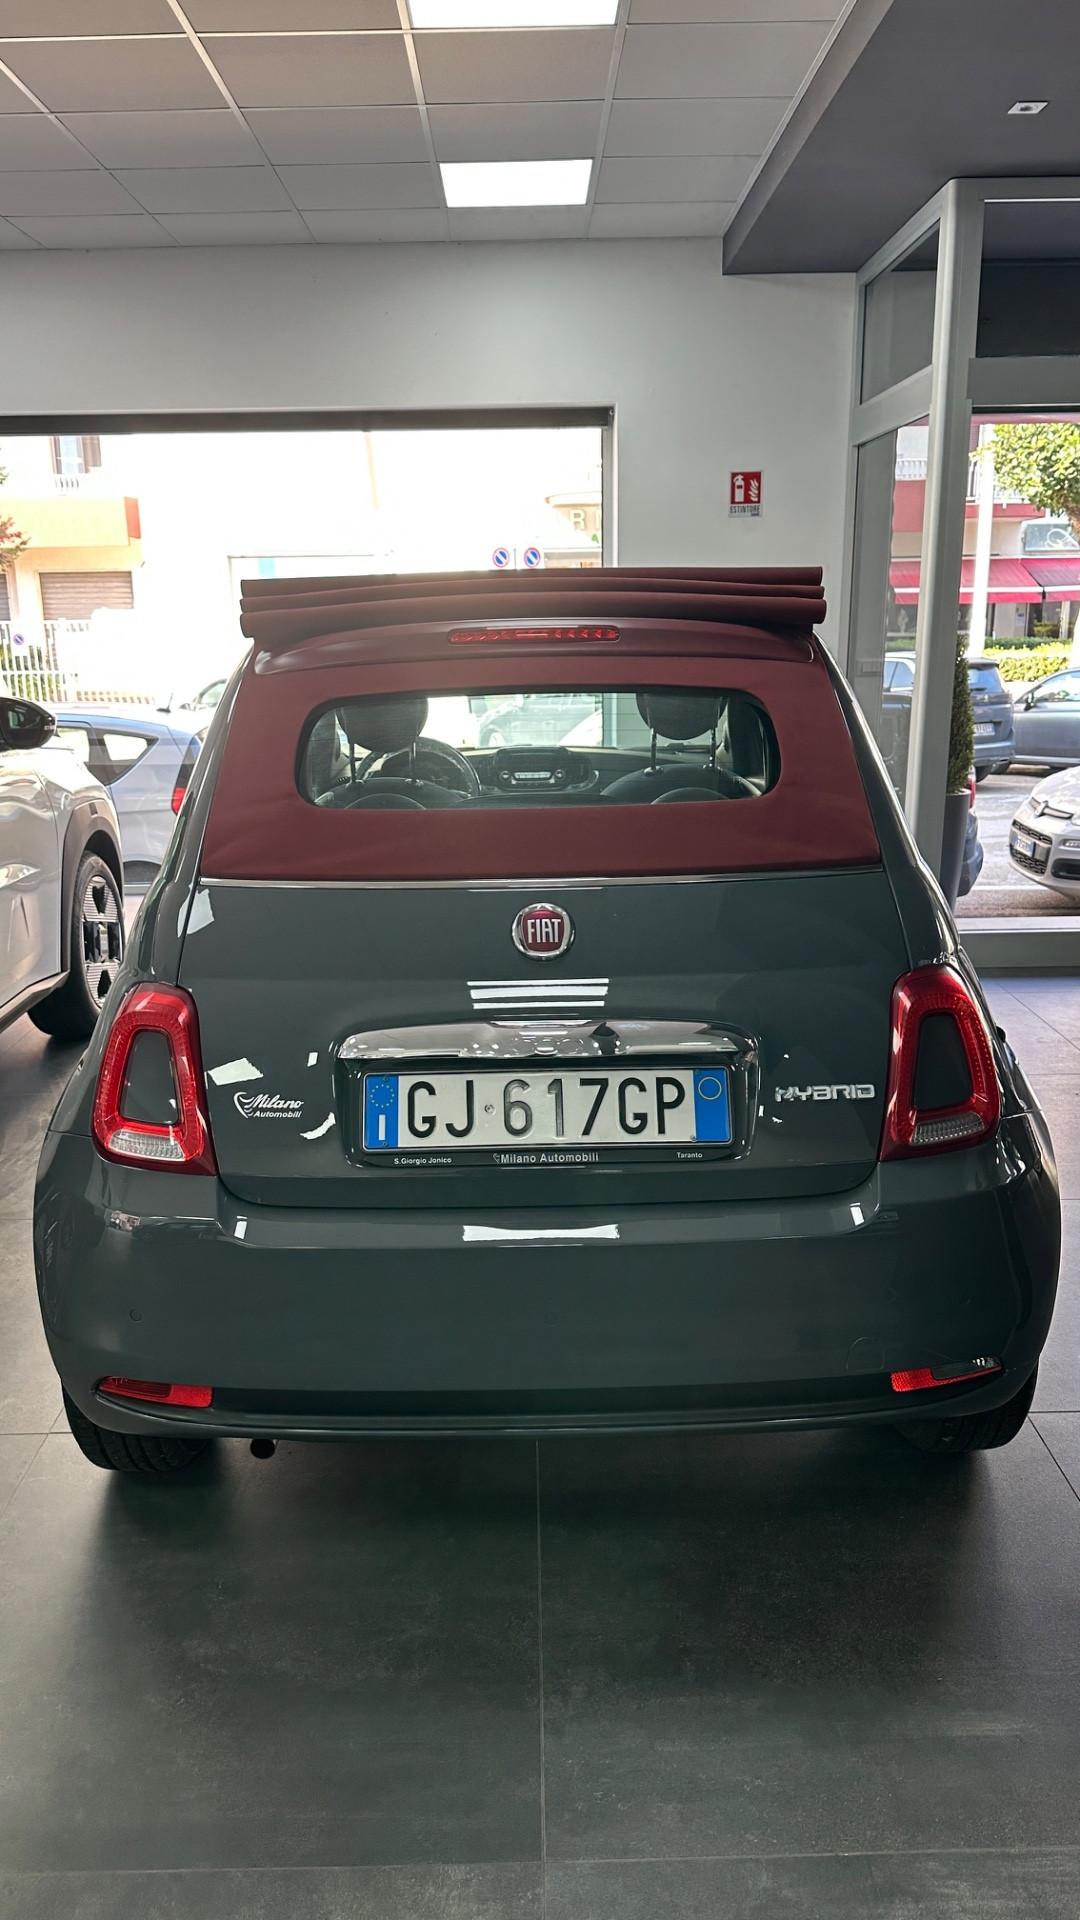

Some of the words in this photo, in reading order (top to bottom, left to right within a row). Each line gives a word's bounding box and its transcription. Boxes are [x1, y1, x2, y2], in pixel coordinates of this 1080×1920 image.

[730, 505, 761, 513] ESTINTORE
[527, 918, 562, 944] FIAT
[775, 1084, 876, 1102] HYBRID
[243, 1094, 305, 1109] Milano
[252, 1110, 302, 1118] Automobili
[501, 1154, 537, 1164] Milano
[540, 1152, 599, 1162] Automobili
[676, 1151, 703, 1159] Taranto
